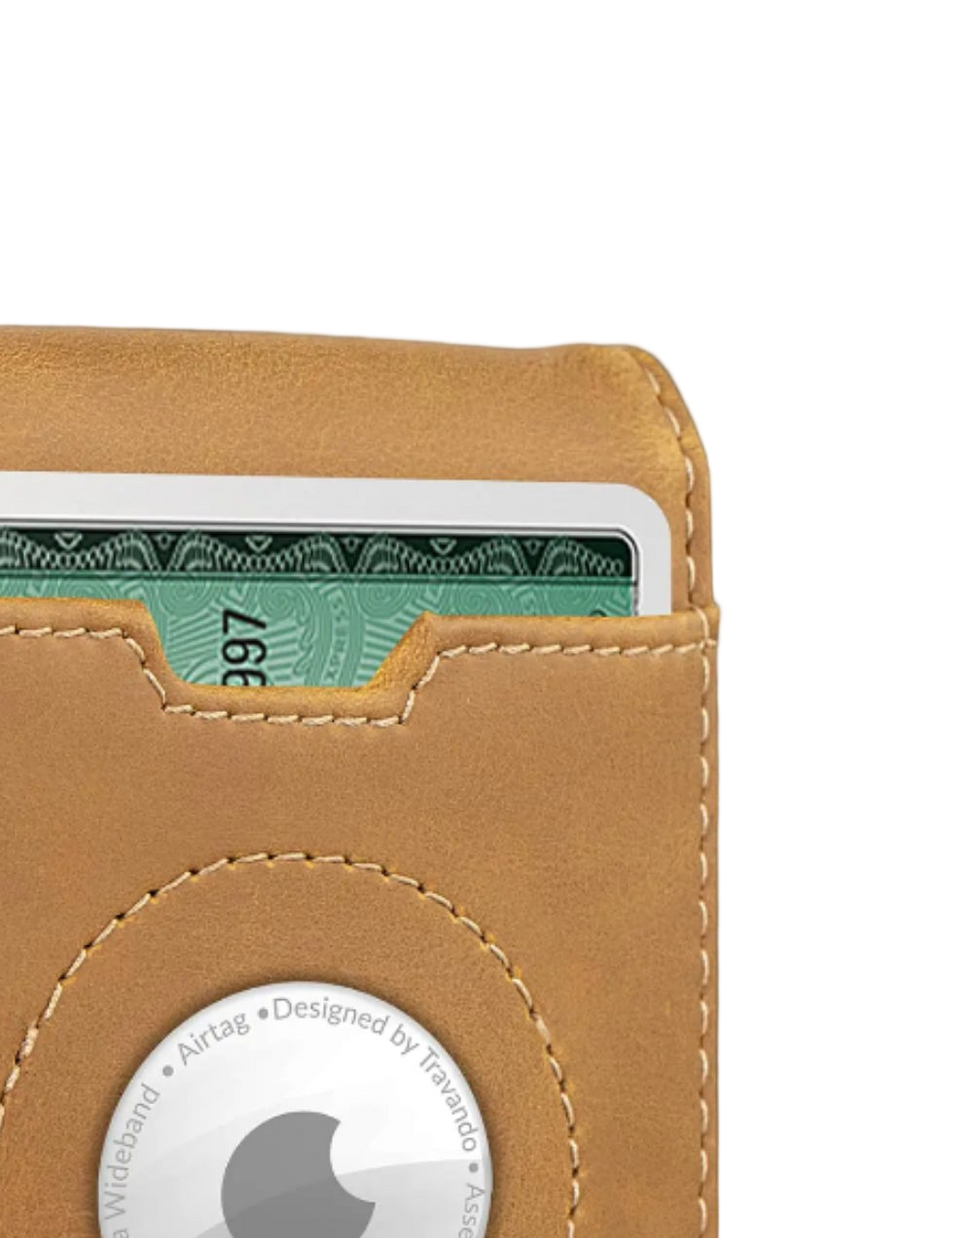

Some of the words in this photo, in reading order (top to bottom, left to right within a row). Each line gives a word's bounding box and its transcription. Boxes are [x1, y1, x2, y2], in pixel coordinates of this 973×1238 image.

[221, 608, 267, 686] 997
[175, 1011, 251, 1066] Airtag
[273, 996, 390, 1036] Designed
[389, 1024, 419, 1055] by
[418, 1047, 477, 1153] Travando
[104, 1083, 161, 1220] Wideband
